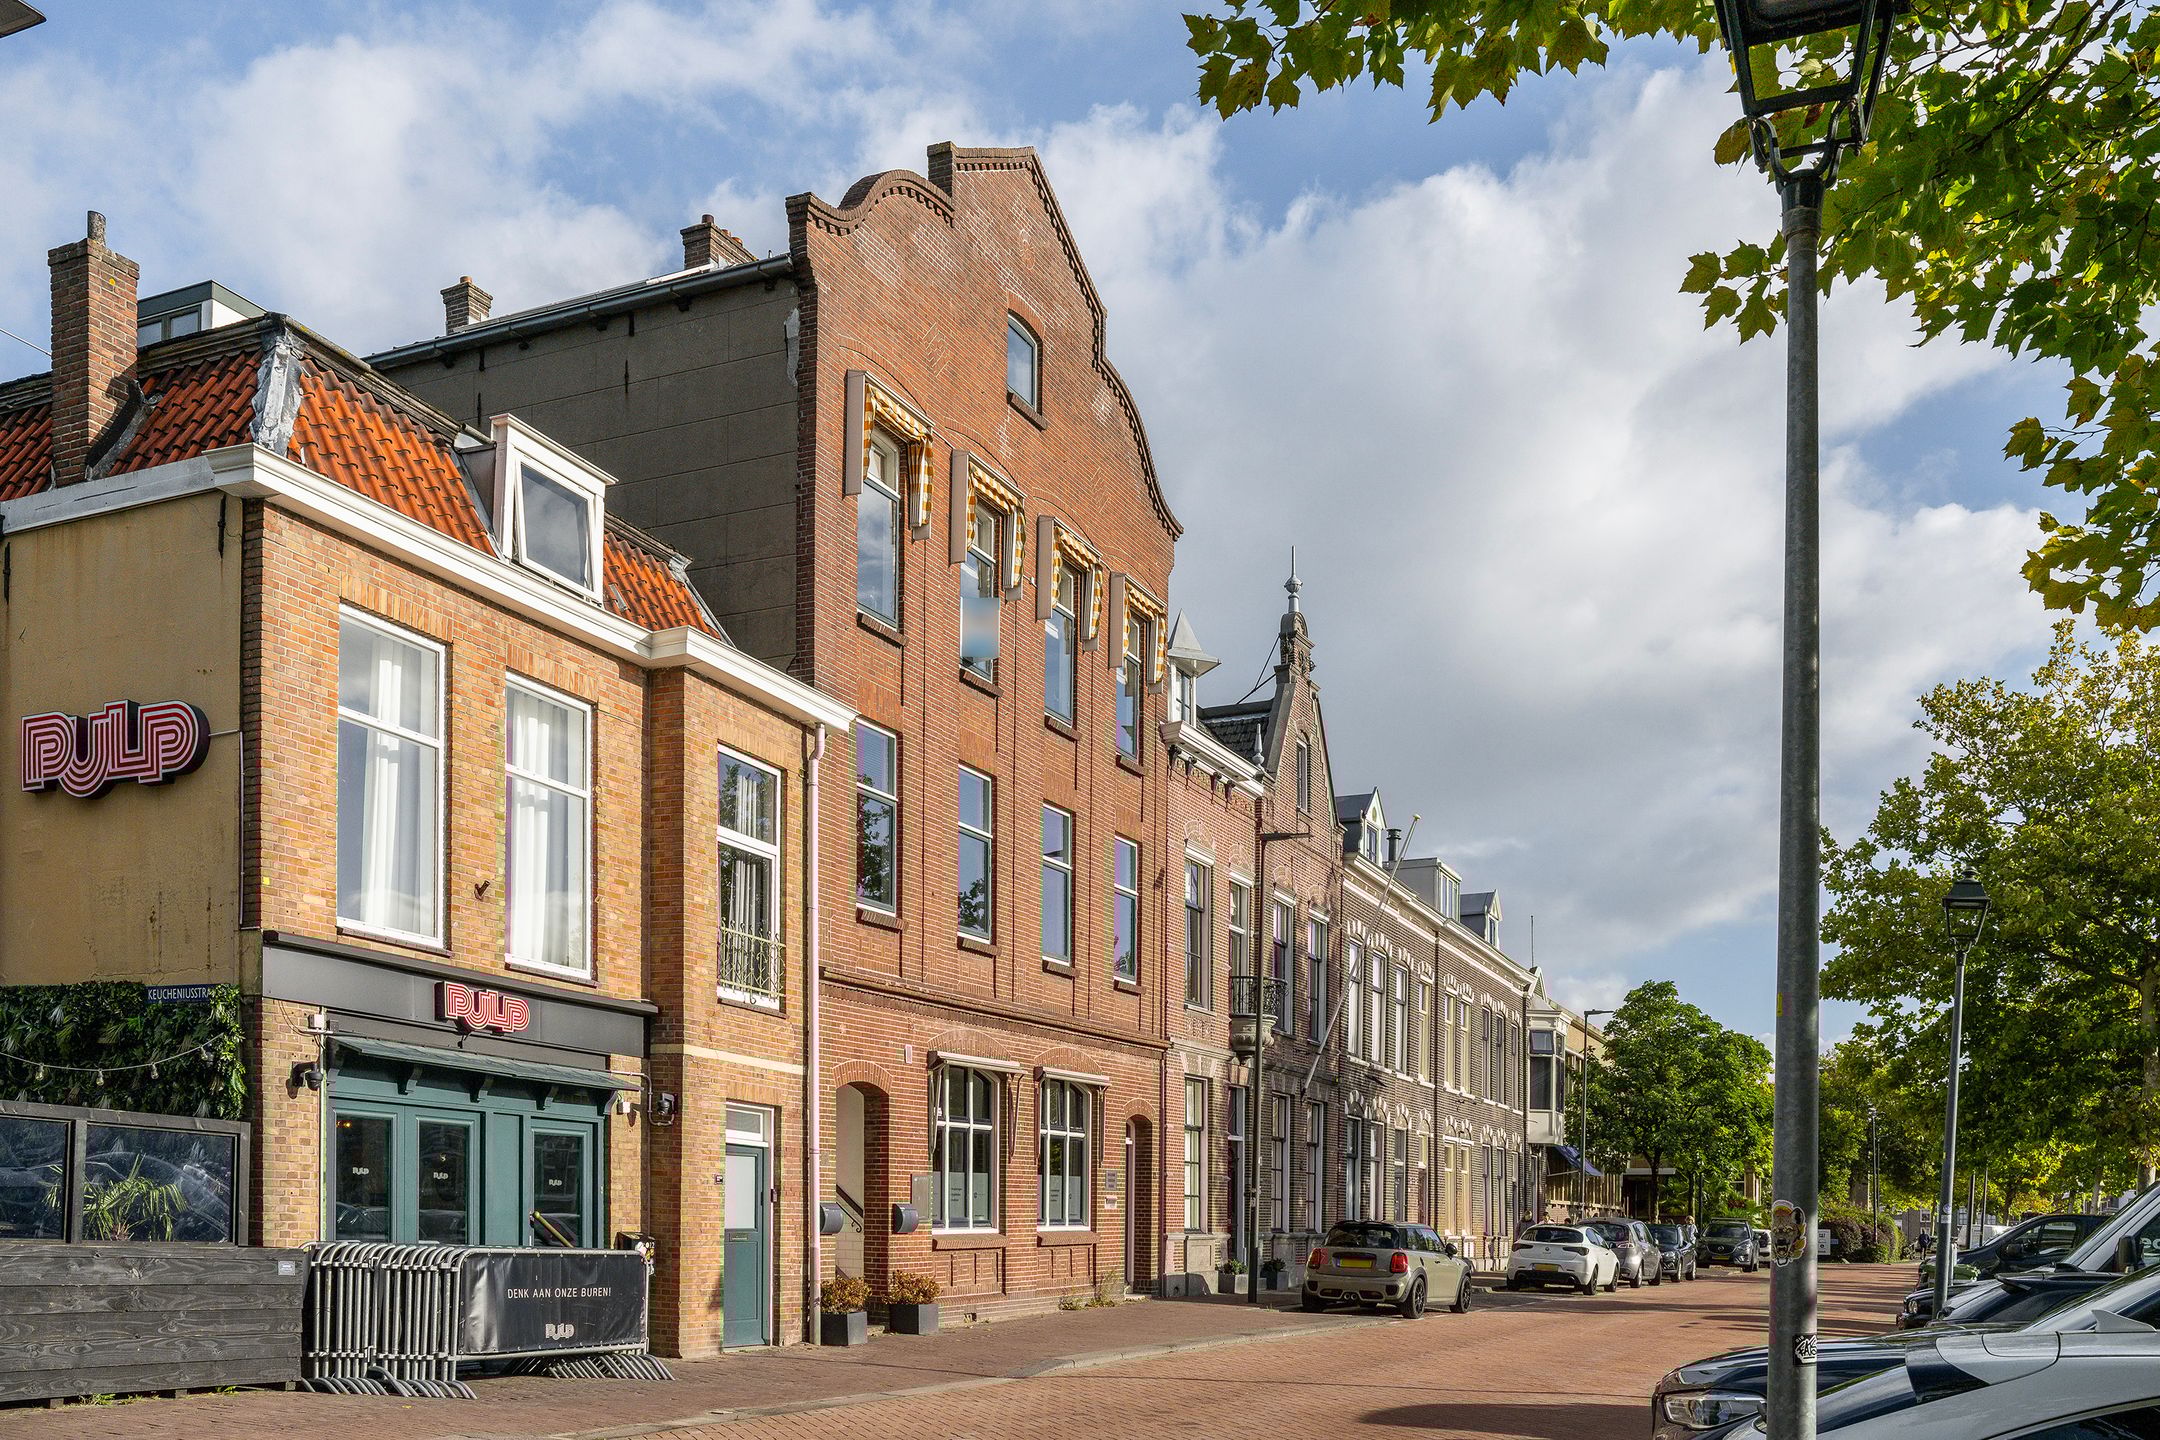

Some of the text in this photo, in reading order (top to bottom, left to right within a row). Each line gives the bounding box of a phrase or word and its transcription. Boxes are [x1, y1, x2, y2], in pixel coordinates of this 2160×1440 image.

[21, 699, 201, 798] PULP
[443, 981, 531, 1033] PULP
[507, 1287, 611, 1299] DENK AAN ONZE BUREN!
